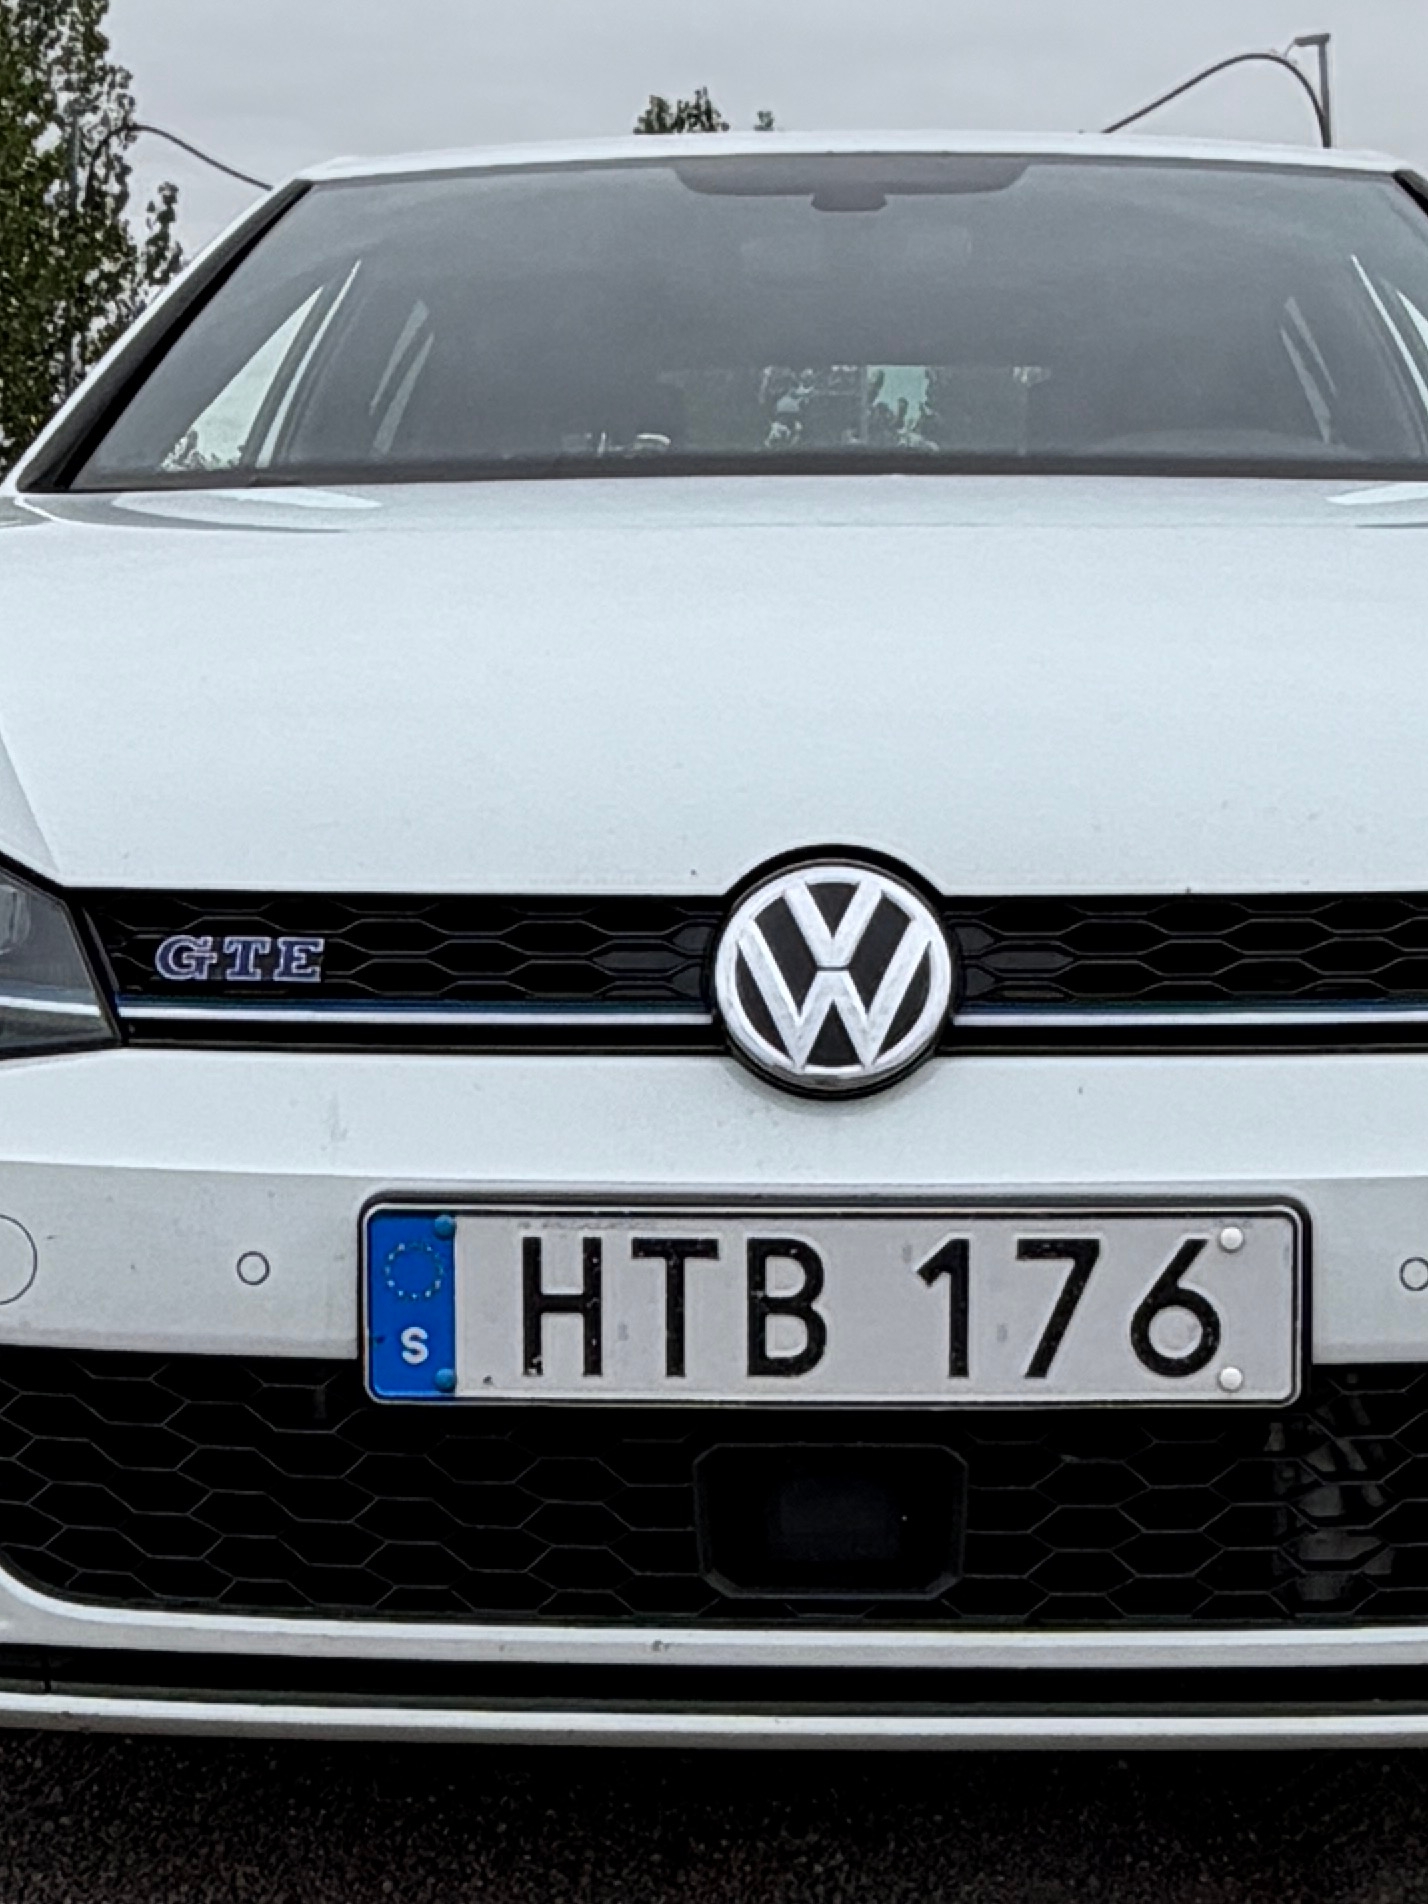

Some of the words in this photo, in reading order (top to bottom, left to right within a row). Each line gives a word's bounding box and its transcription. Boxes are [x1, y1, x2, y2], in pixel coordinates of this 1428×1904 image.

[155, 935, 325, 982] GTE
[523, 1237, 827, 1378] HTB
[917, 1238, 1221, 1378] 176
[401, 1327, 430, 1363] S
